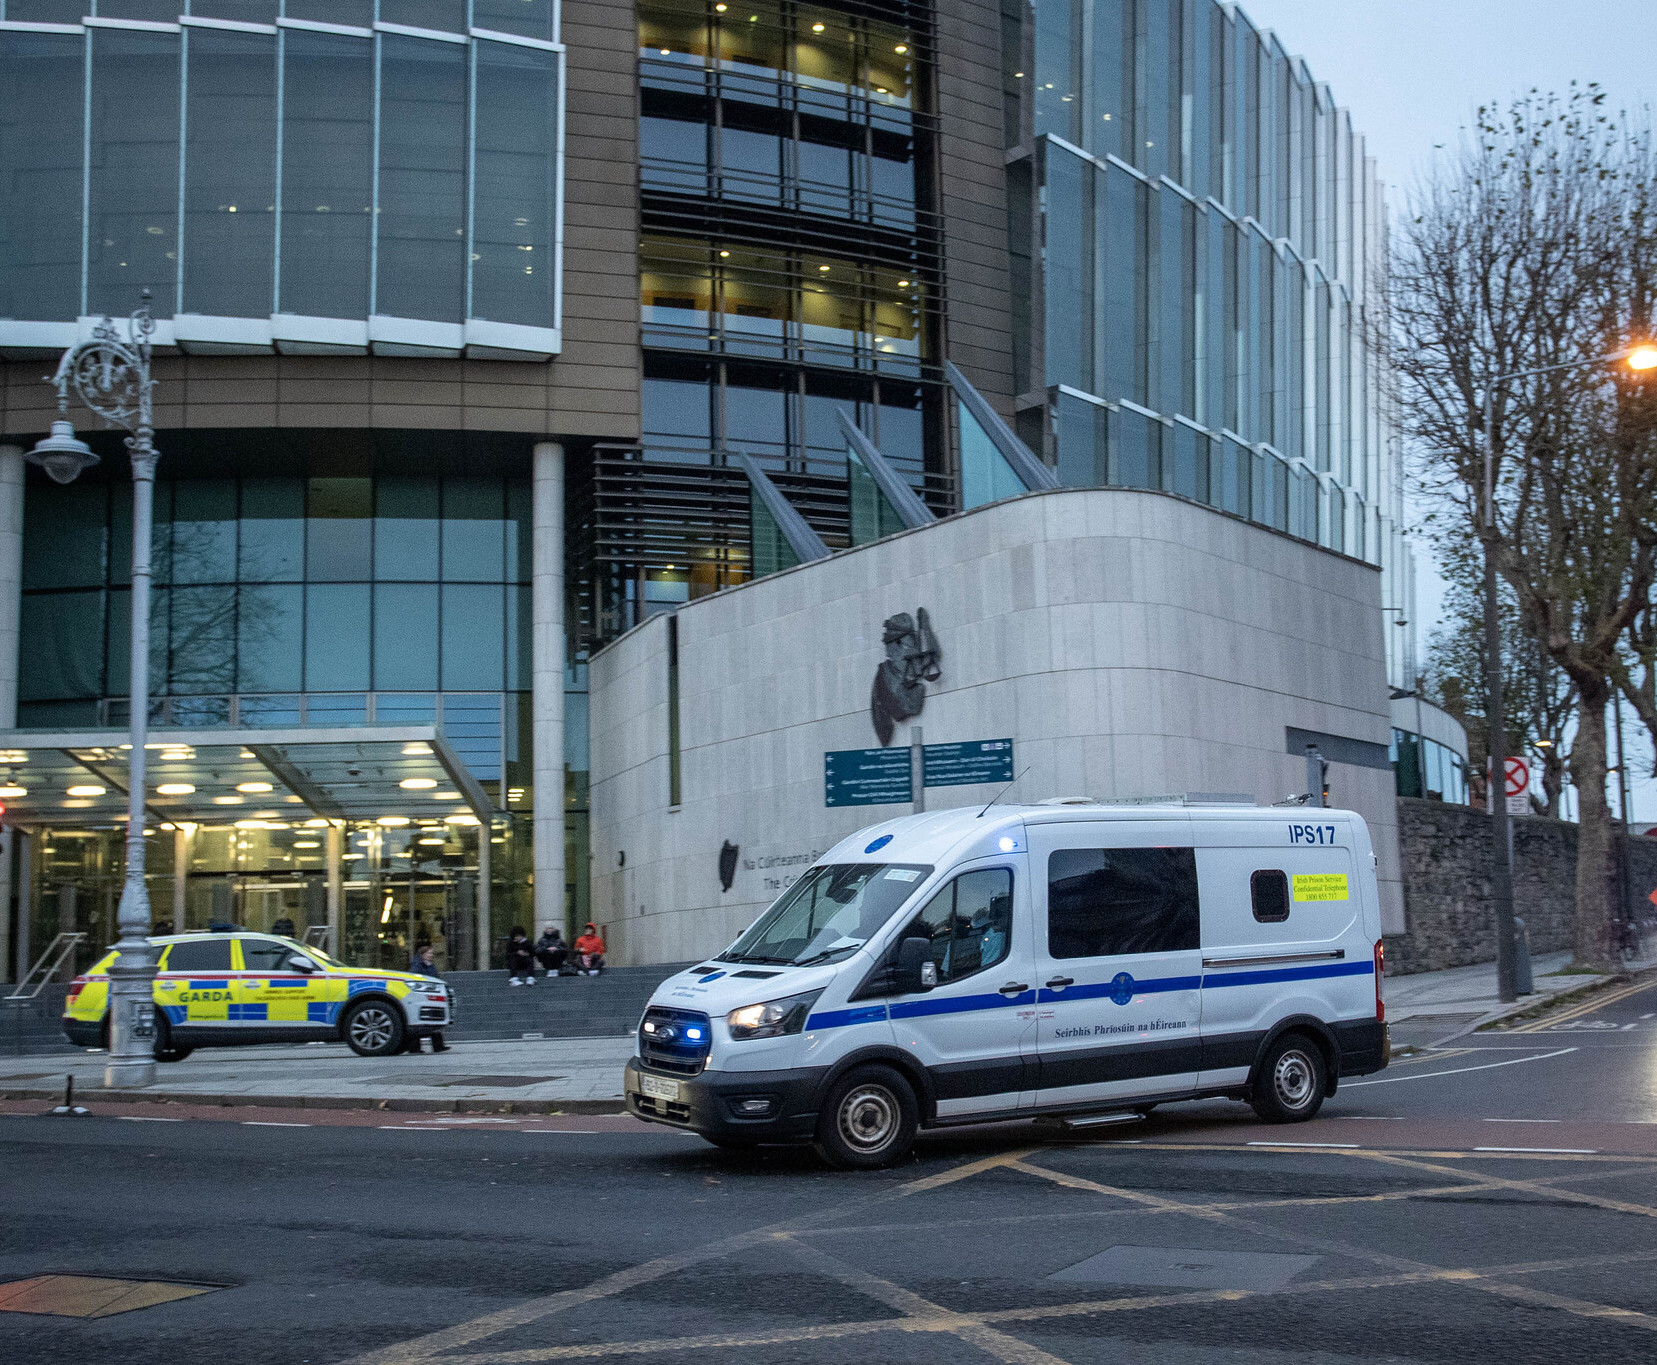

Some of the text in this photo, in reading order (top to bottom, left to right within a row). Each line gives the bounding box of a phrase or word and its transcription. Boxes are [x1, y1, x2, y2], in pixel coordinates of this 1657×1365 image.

[1288, 824, 1336, 845] IPS17
[763, 877, 781, 890] The
[1296, 876, 1308, 884] Irish
[179, 991, 234, 1003] GARDA
[1055, 1018, 1187, 1039] Seirbhís Phríosúin na hÉireann
